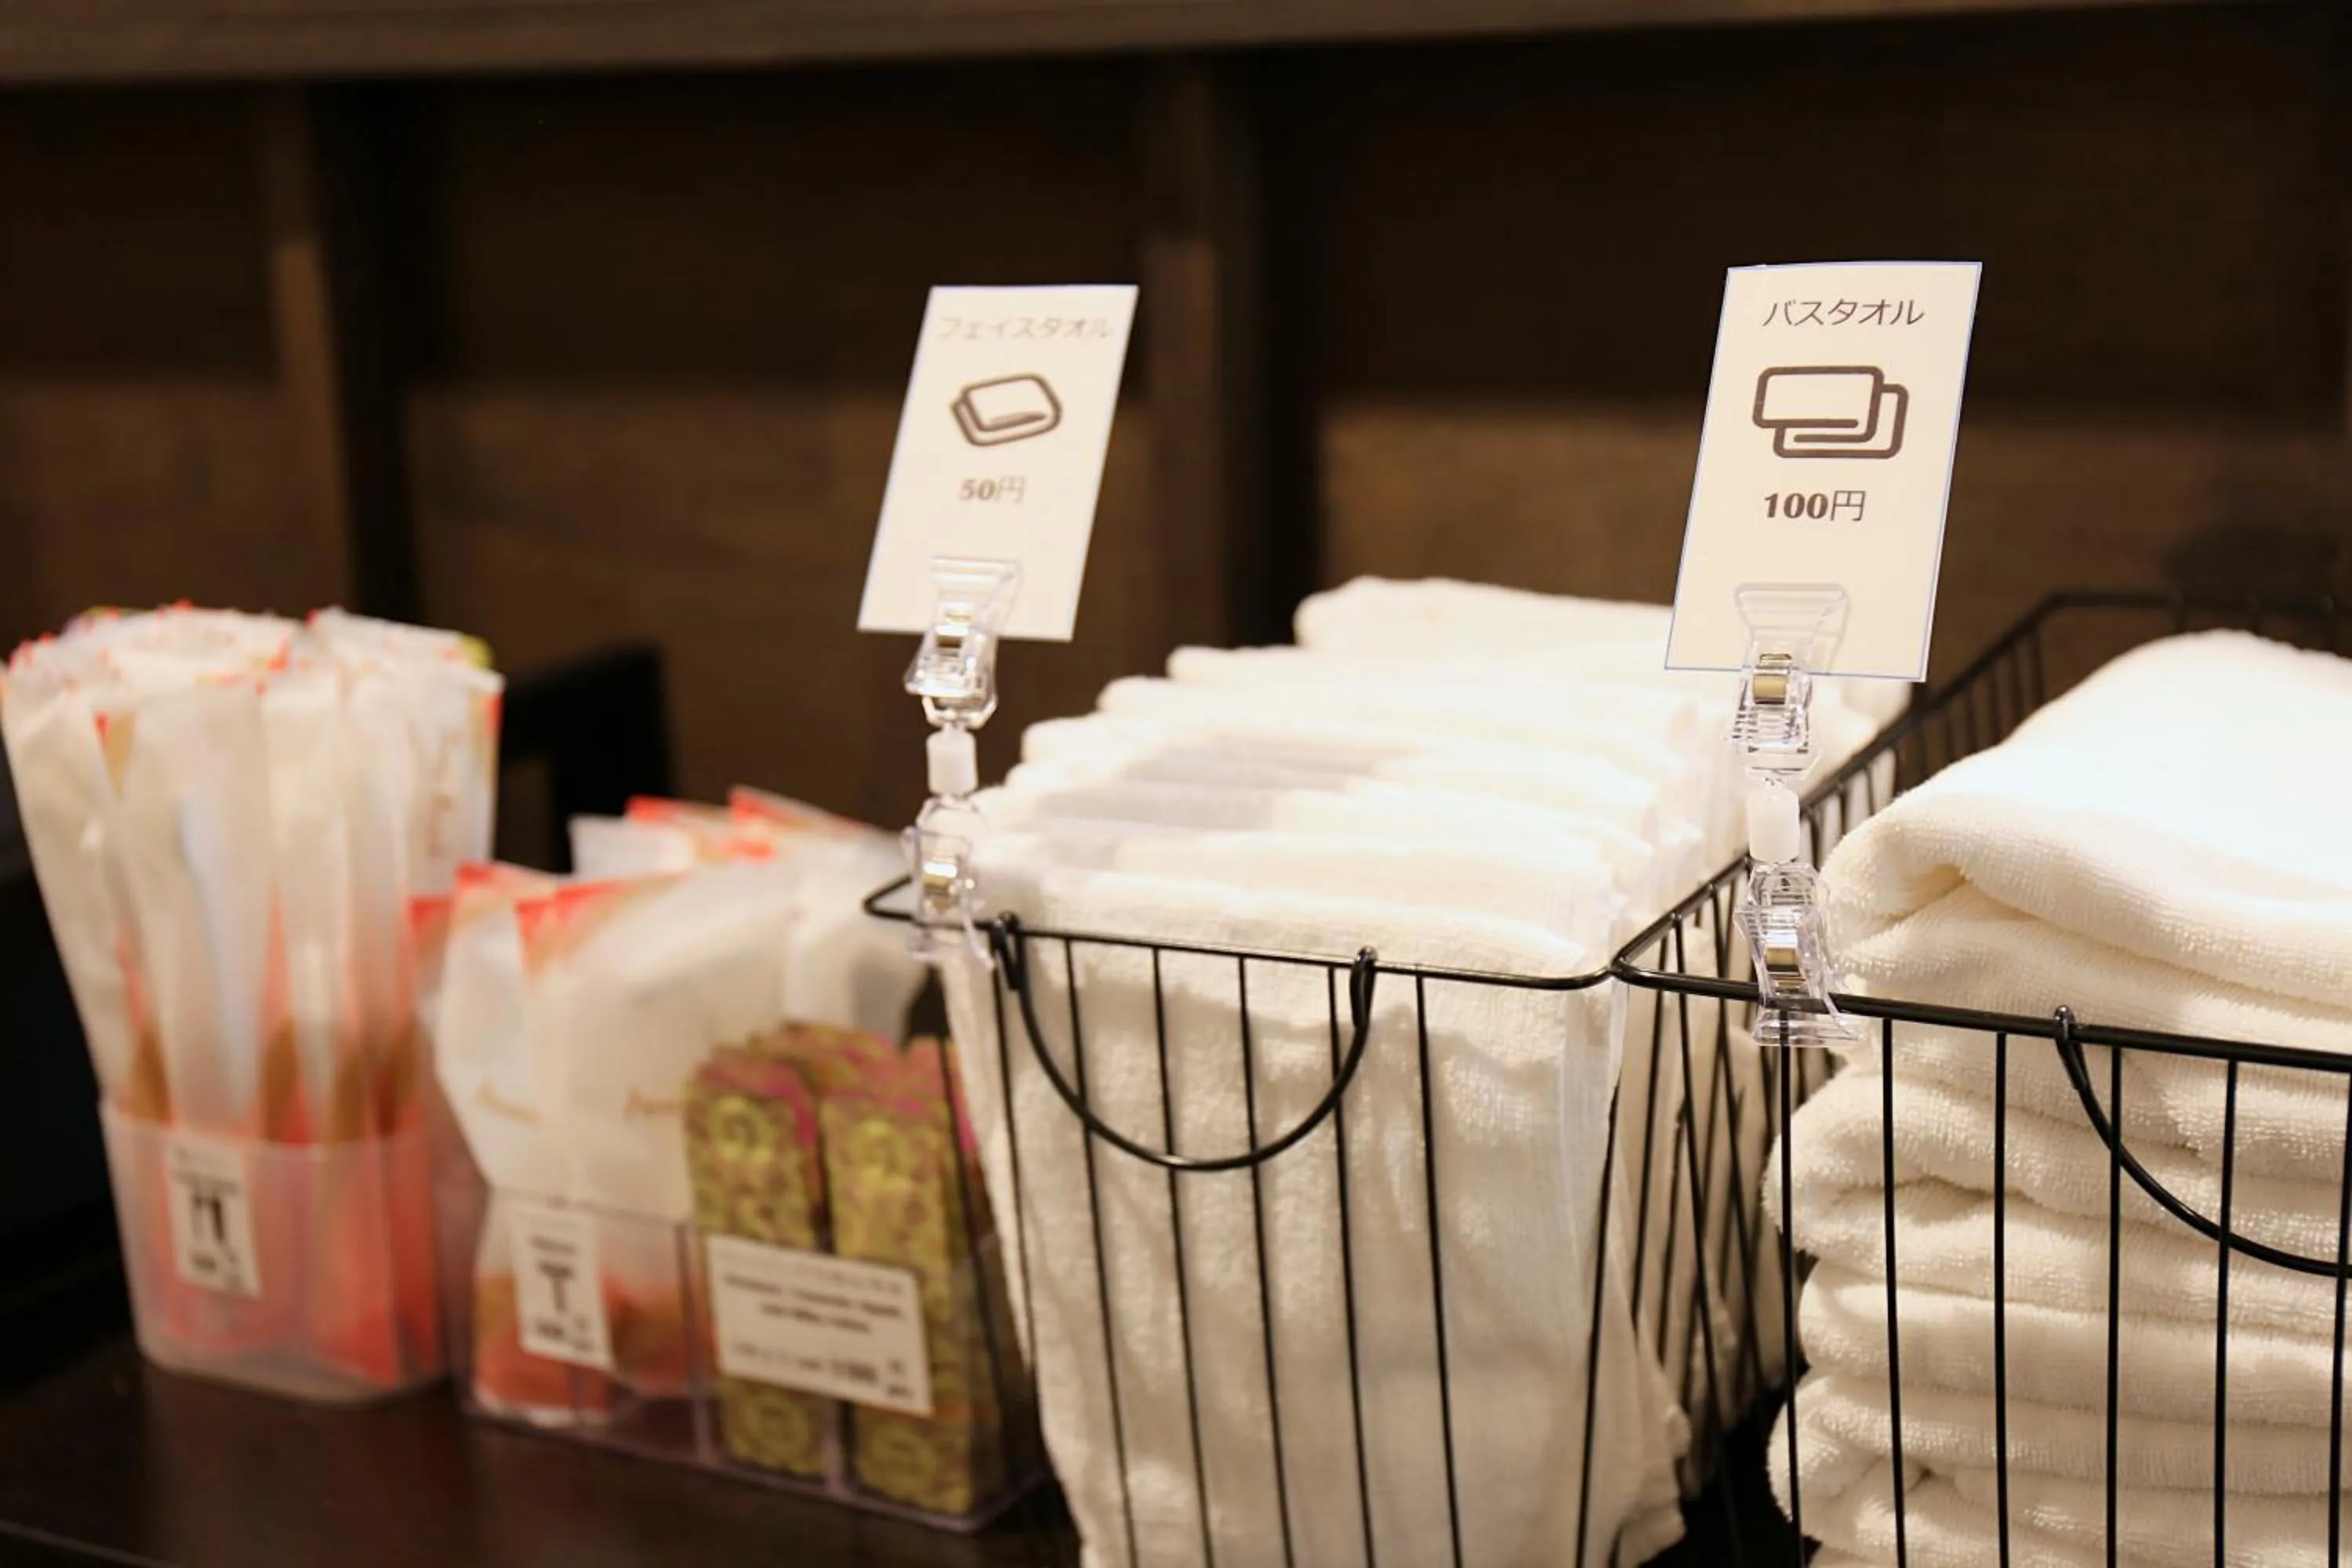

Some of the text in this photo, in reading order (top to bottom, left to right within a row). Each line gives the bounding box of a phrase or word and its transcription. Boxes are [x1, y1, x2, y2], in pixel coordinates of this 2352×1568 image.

[1762, 298, 1926, 326] バスタオル
[941, 316, 1113, 339] フェイスタオル
[960, 475, 1025, 503] 50円
[1764, 490, 1866, 521] 100円
